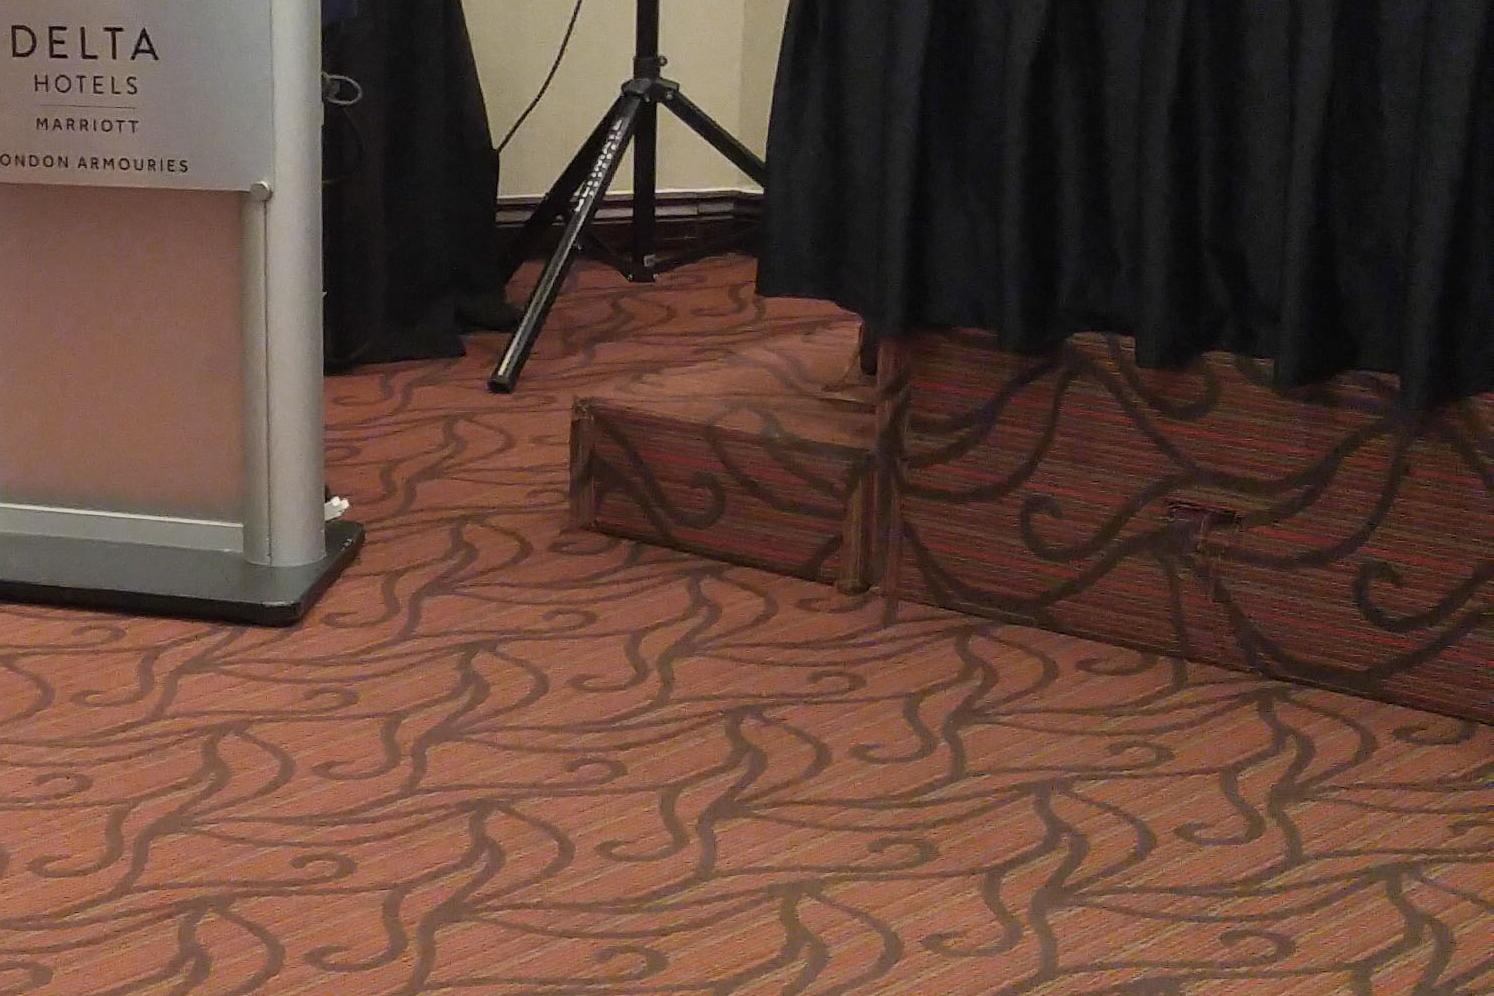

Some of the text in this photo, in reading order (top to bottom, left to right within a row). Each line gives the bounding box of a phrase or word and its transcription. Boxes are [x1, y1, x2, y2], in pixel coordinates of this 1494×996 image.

[10, 24, 160, 62] DELTA
[33, 73, 138, 96] HOTELS
[35, 117, 140, 134] MARRIOTT
[77, 155, 189, 173] ARMOURIES
